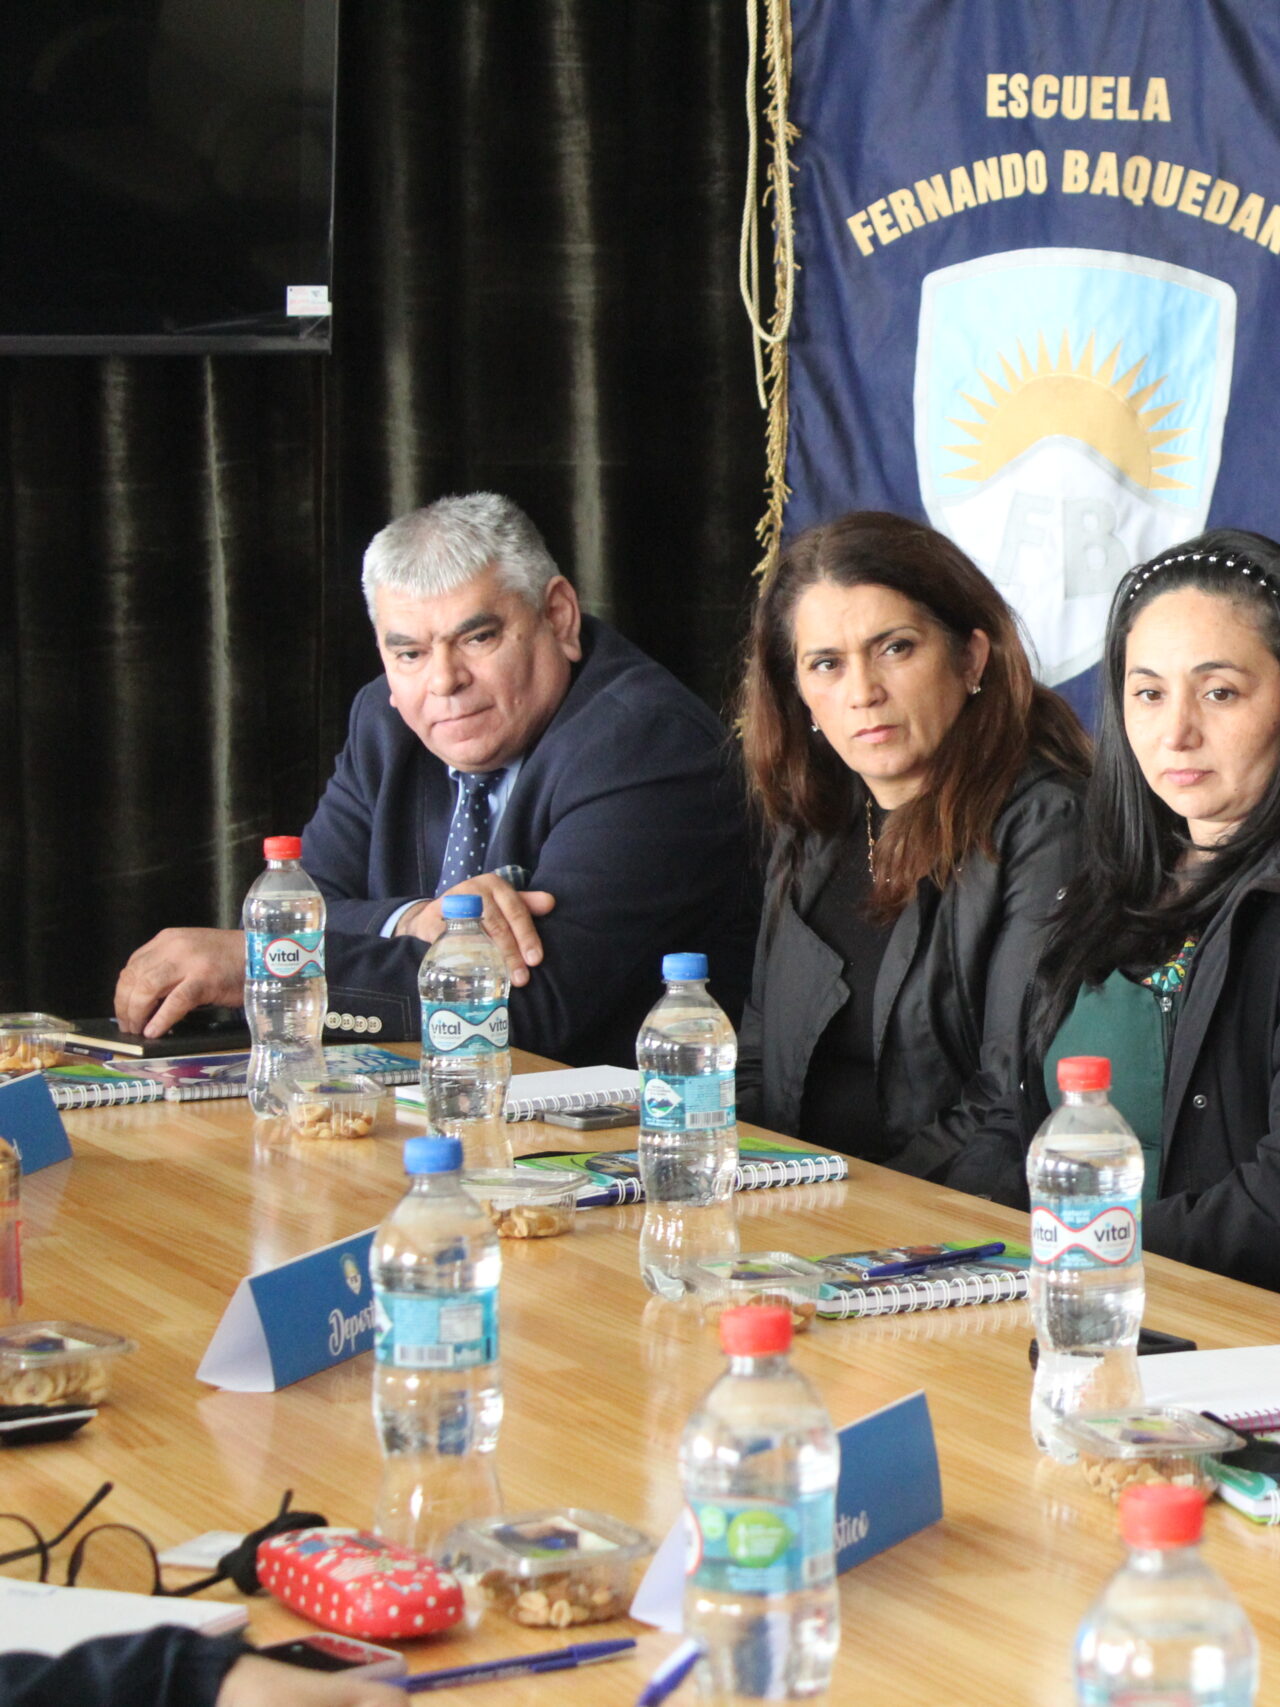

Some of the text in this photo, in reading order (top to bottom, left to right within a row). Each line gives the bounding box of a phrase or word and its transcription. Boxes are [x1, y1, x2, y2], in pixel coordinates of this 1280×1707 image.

[986, 73, 1171, 121] ESCUELA
[846, 149, 1048, 257] FERNANDO
[993, 490, 1132, 600] FB
[268, 948, 300, 962] vital
[431, 1019, 461, 1035] vital
[488, 1017, 508, 1032] vita
[1094, 1222, 1131, 1242] vital
